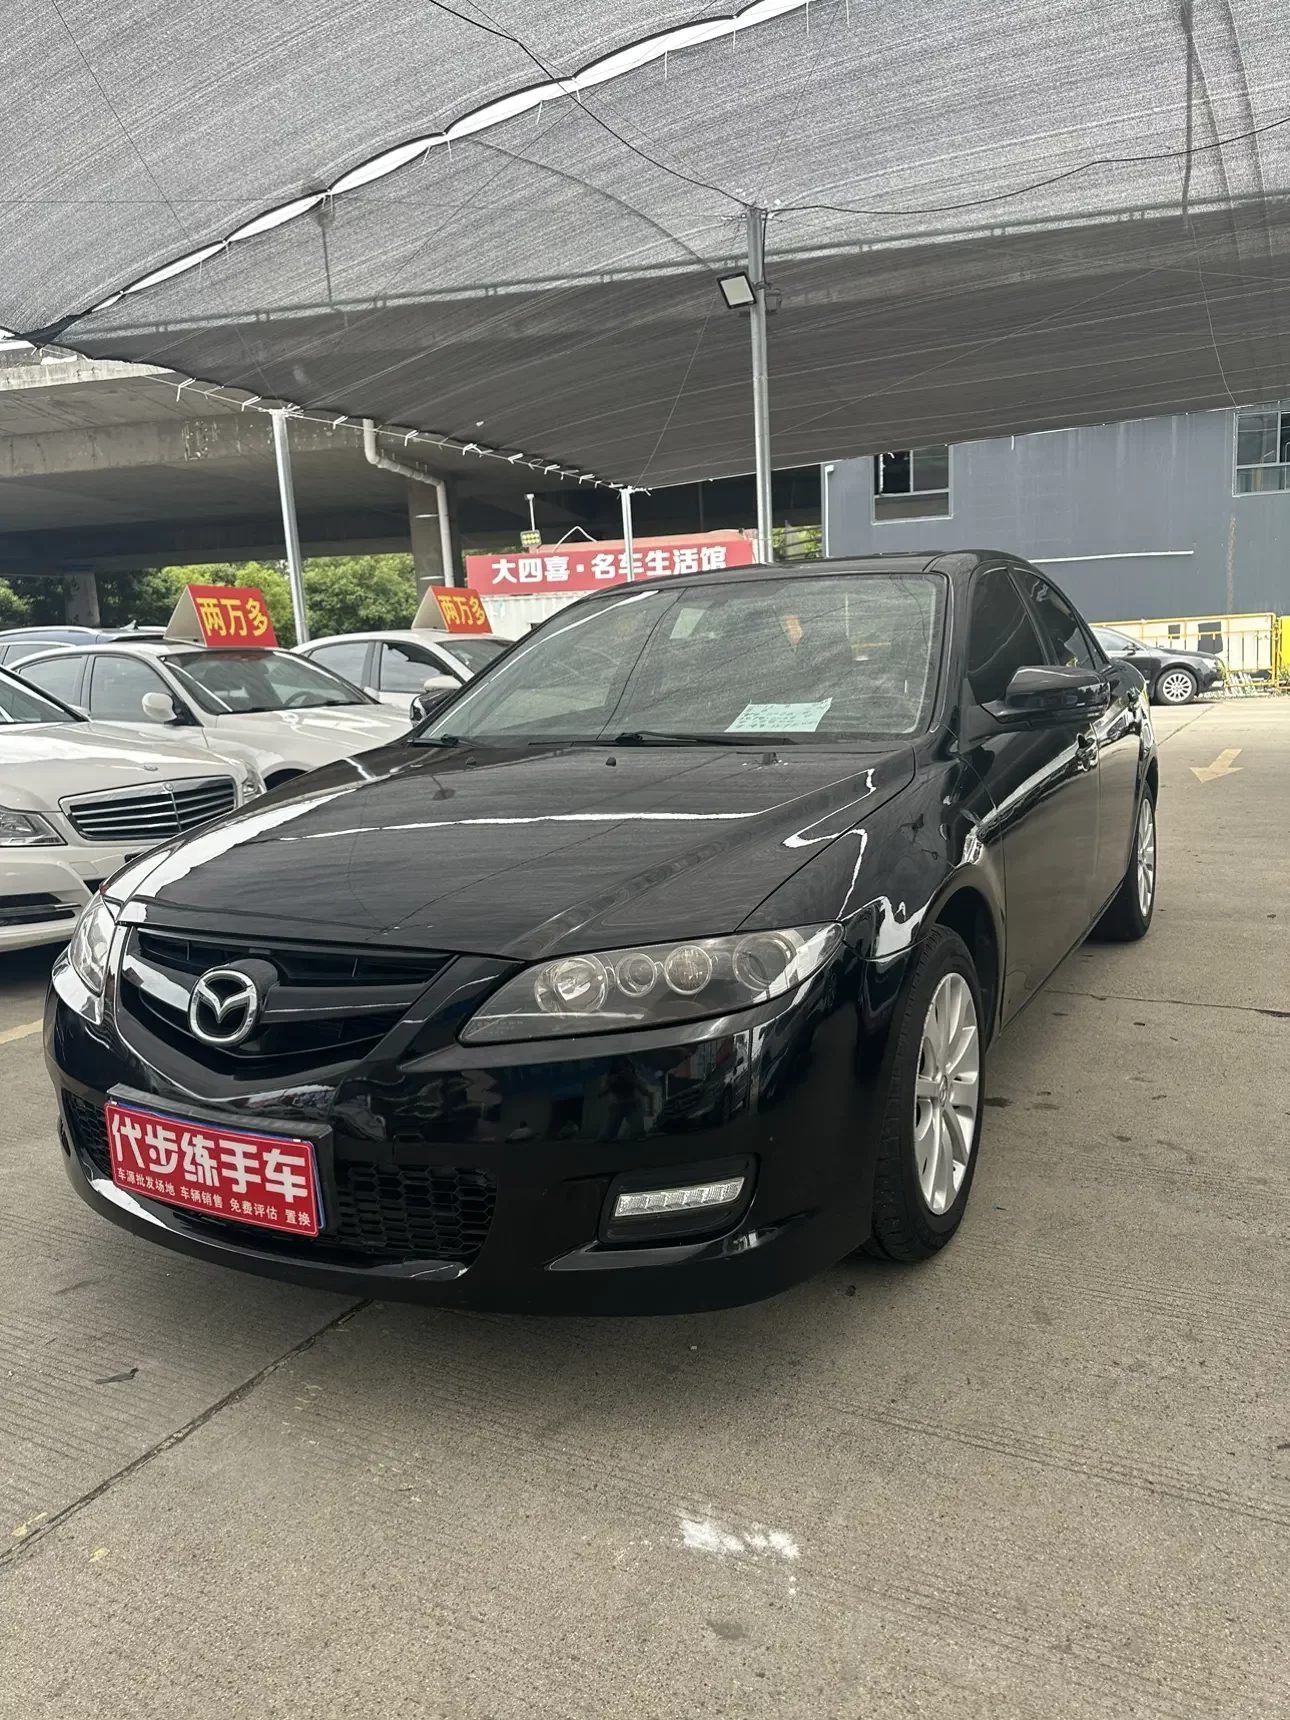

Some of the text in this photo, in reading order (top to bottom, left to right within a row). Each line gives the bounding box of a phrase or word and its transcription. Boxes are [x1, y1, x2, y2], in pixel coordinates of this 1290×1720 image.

[491, 546, 727, 584] 大四喜·名车生活馆
[196, 597, 269, 637] 两万多
[437, 594, 486, 626] 两万多
[112, 1113, 308, 1203] 代步练手车
[117, 1168, 311, 1227] 车源批发场地 车辆销售 免费评估 置换
